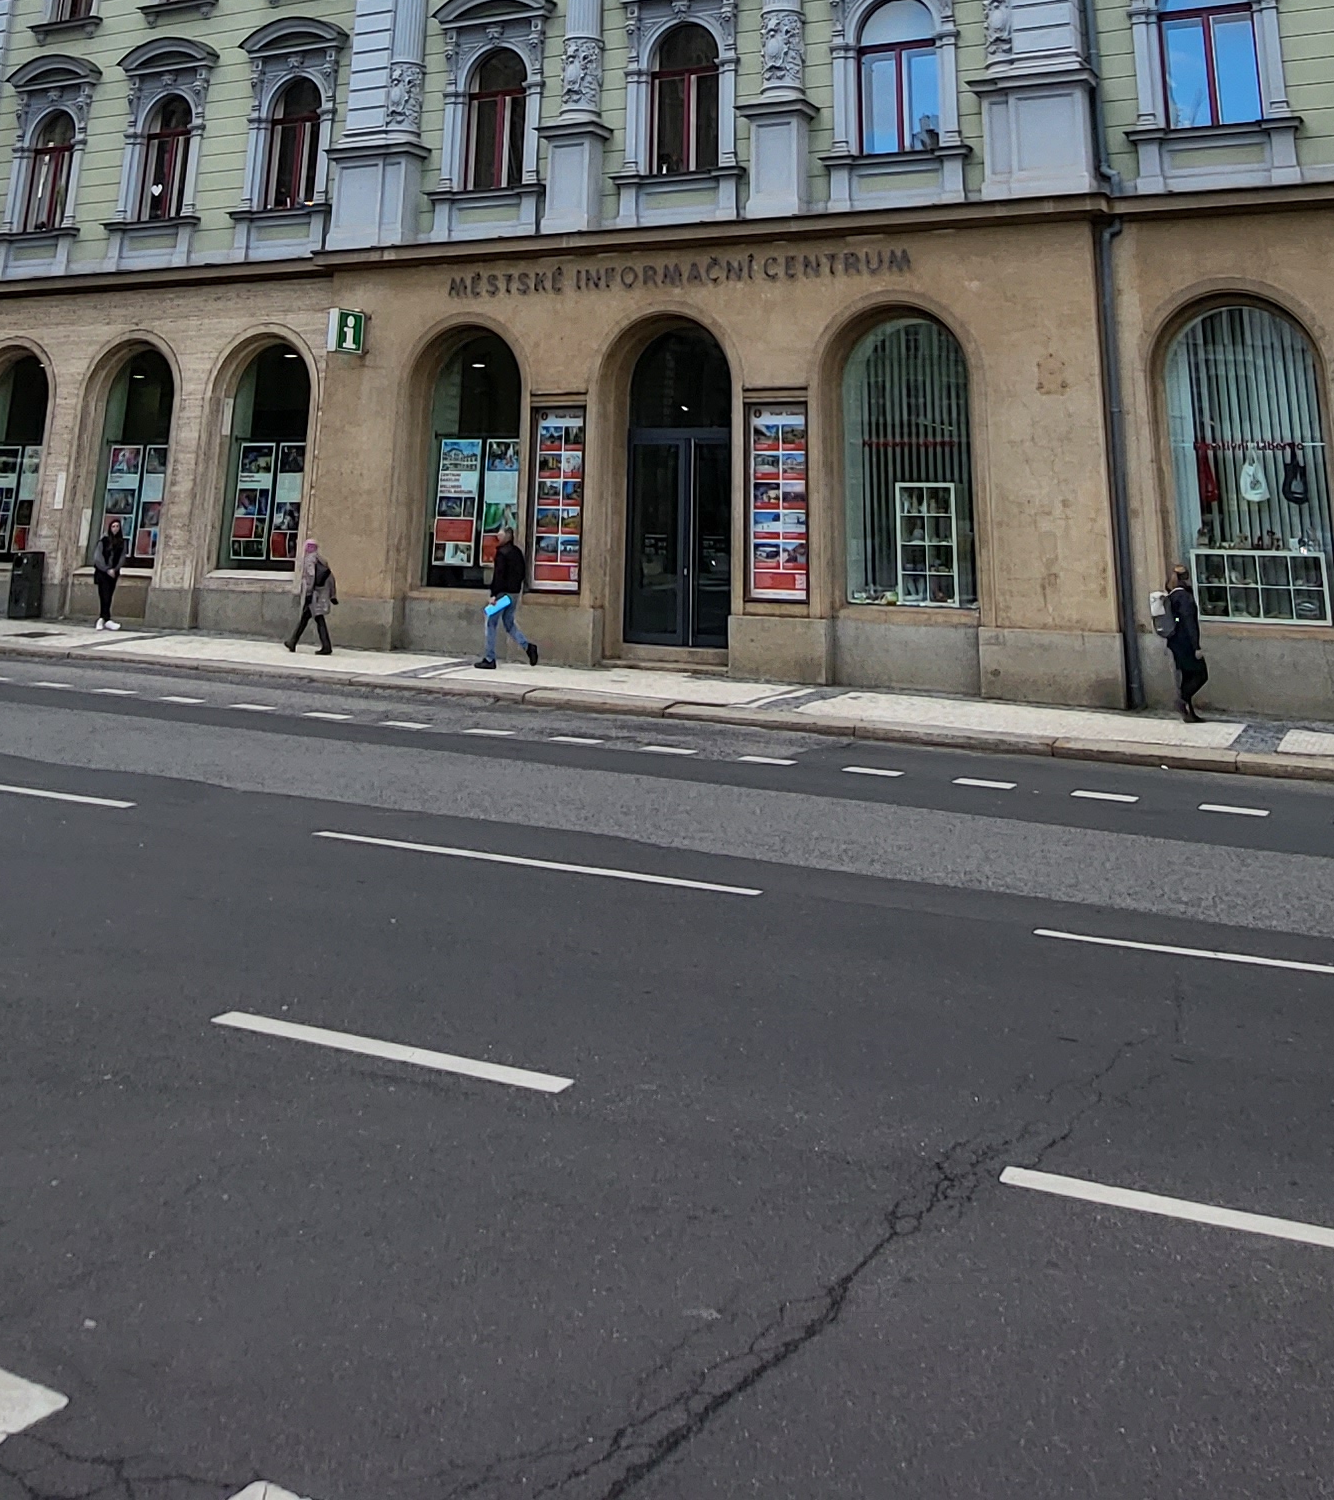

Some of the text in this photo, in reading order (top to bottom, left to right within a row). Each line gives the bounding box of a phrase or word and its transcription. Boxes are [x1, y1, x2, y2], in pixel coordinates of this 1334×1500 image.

[448, 248, 911, 298] MĚSTSKÉ INFORMAČNÍ CENTRUM
[1255, 440, 1304, 451] Liberc
